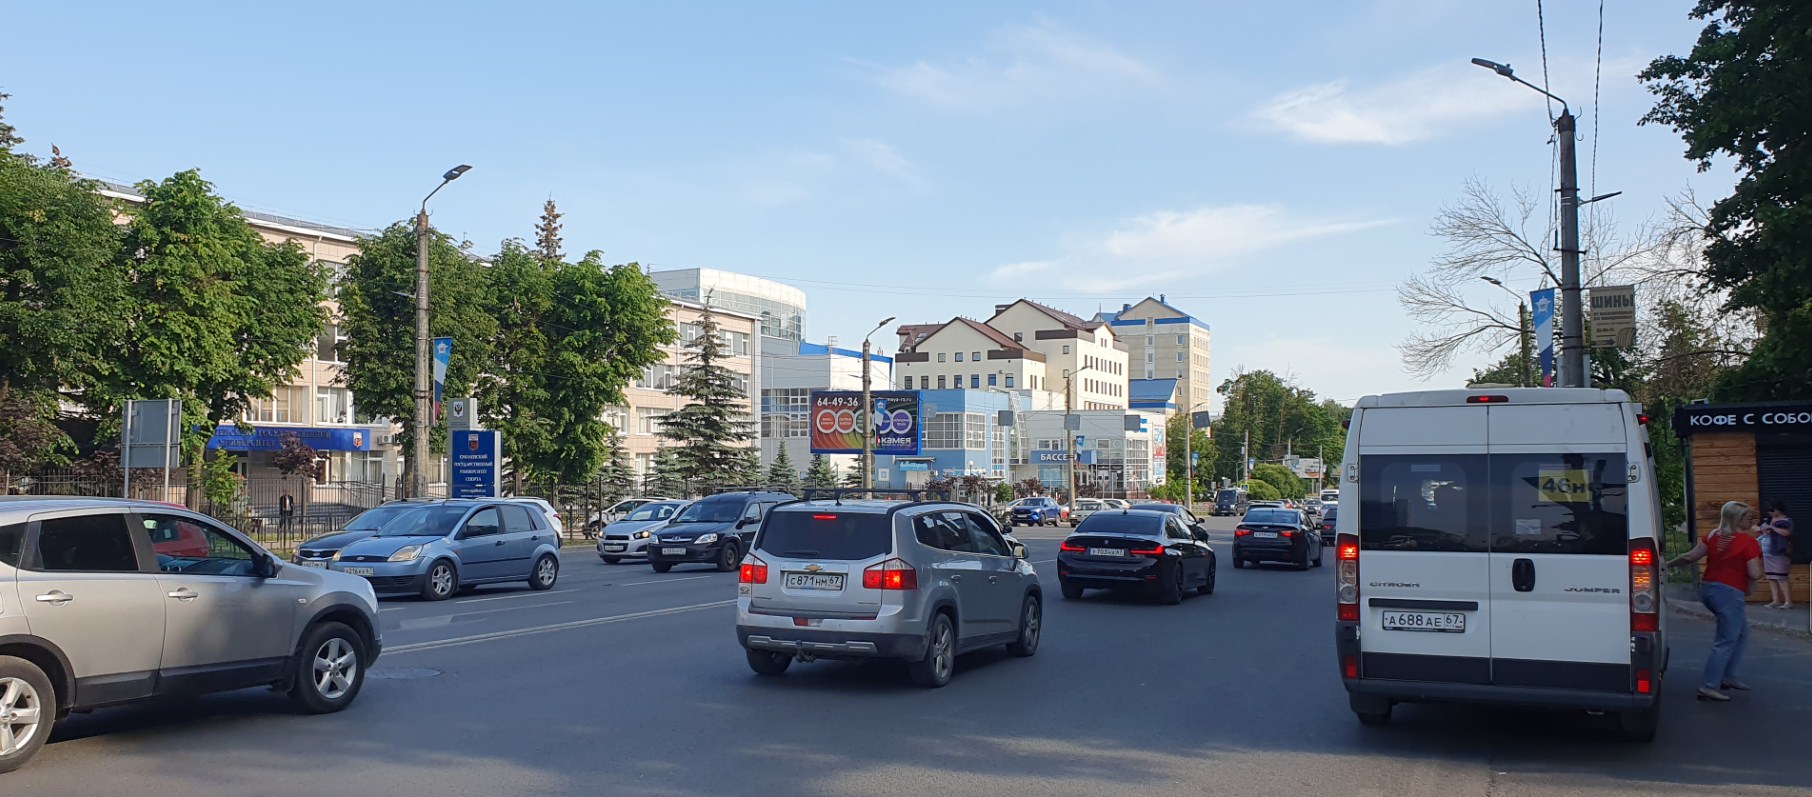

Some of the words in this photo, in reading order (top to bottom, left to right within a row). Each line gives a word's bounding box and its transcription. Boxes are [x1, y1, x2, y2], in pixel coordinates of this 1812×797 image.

[1591, 295, 1634, 308] ШИНЫ
[817, 397, 859, 407] 64-49-36
[1690, 414, 1737, 426] КОФЕ
[1743, 413, 1755, 425] С
[1762, 412, 1812, 425] СОБО
[1564, 586, 1621, 594] JUMPER
